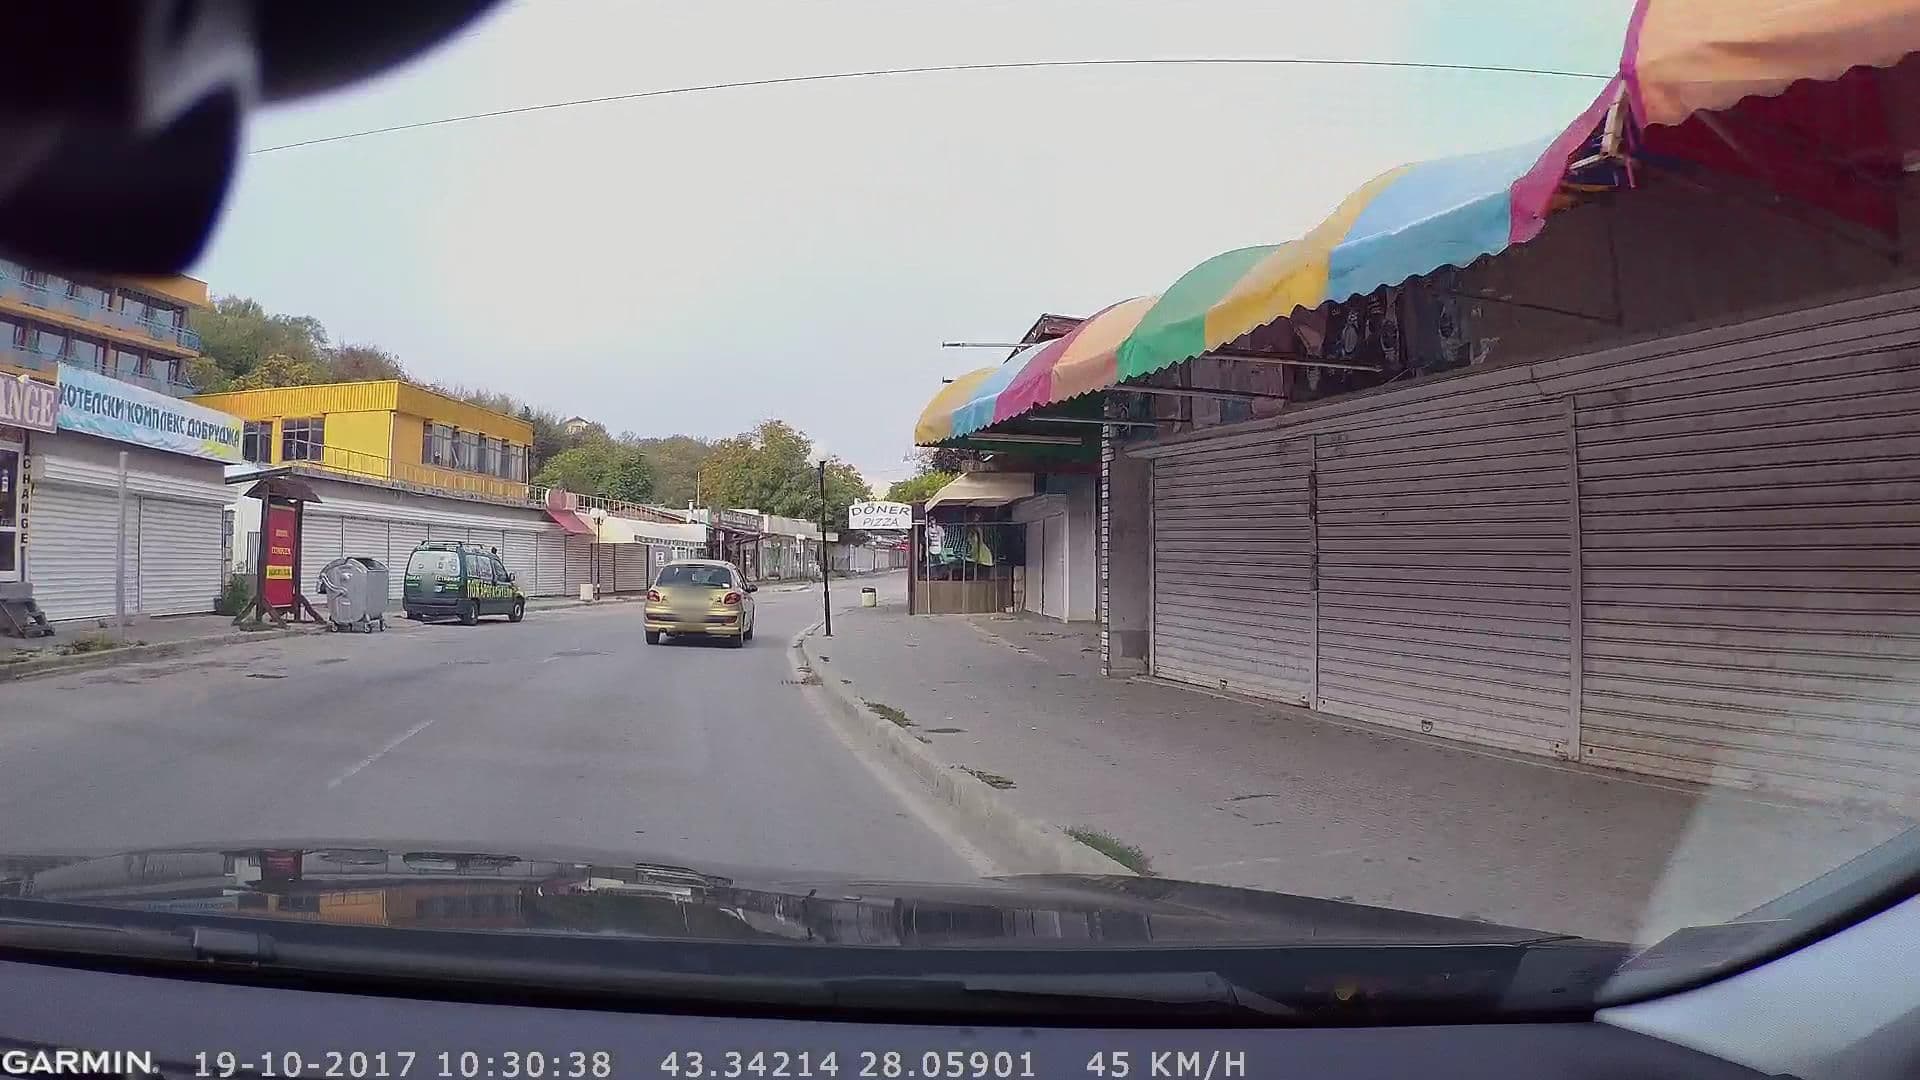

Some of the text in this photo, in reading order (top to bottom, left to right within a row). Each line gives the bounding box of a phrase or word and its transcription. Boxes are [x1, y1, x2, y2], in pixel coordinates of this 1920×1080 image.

[59, 382, 240, 448] ХОТЕЛСКИ КОМПЛЕКС ДОБРУДЖА
[851, 503, 910, 516] DÖNER
[863, 517, 899, 527] PIZZA
